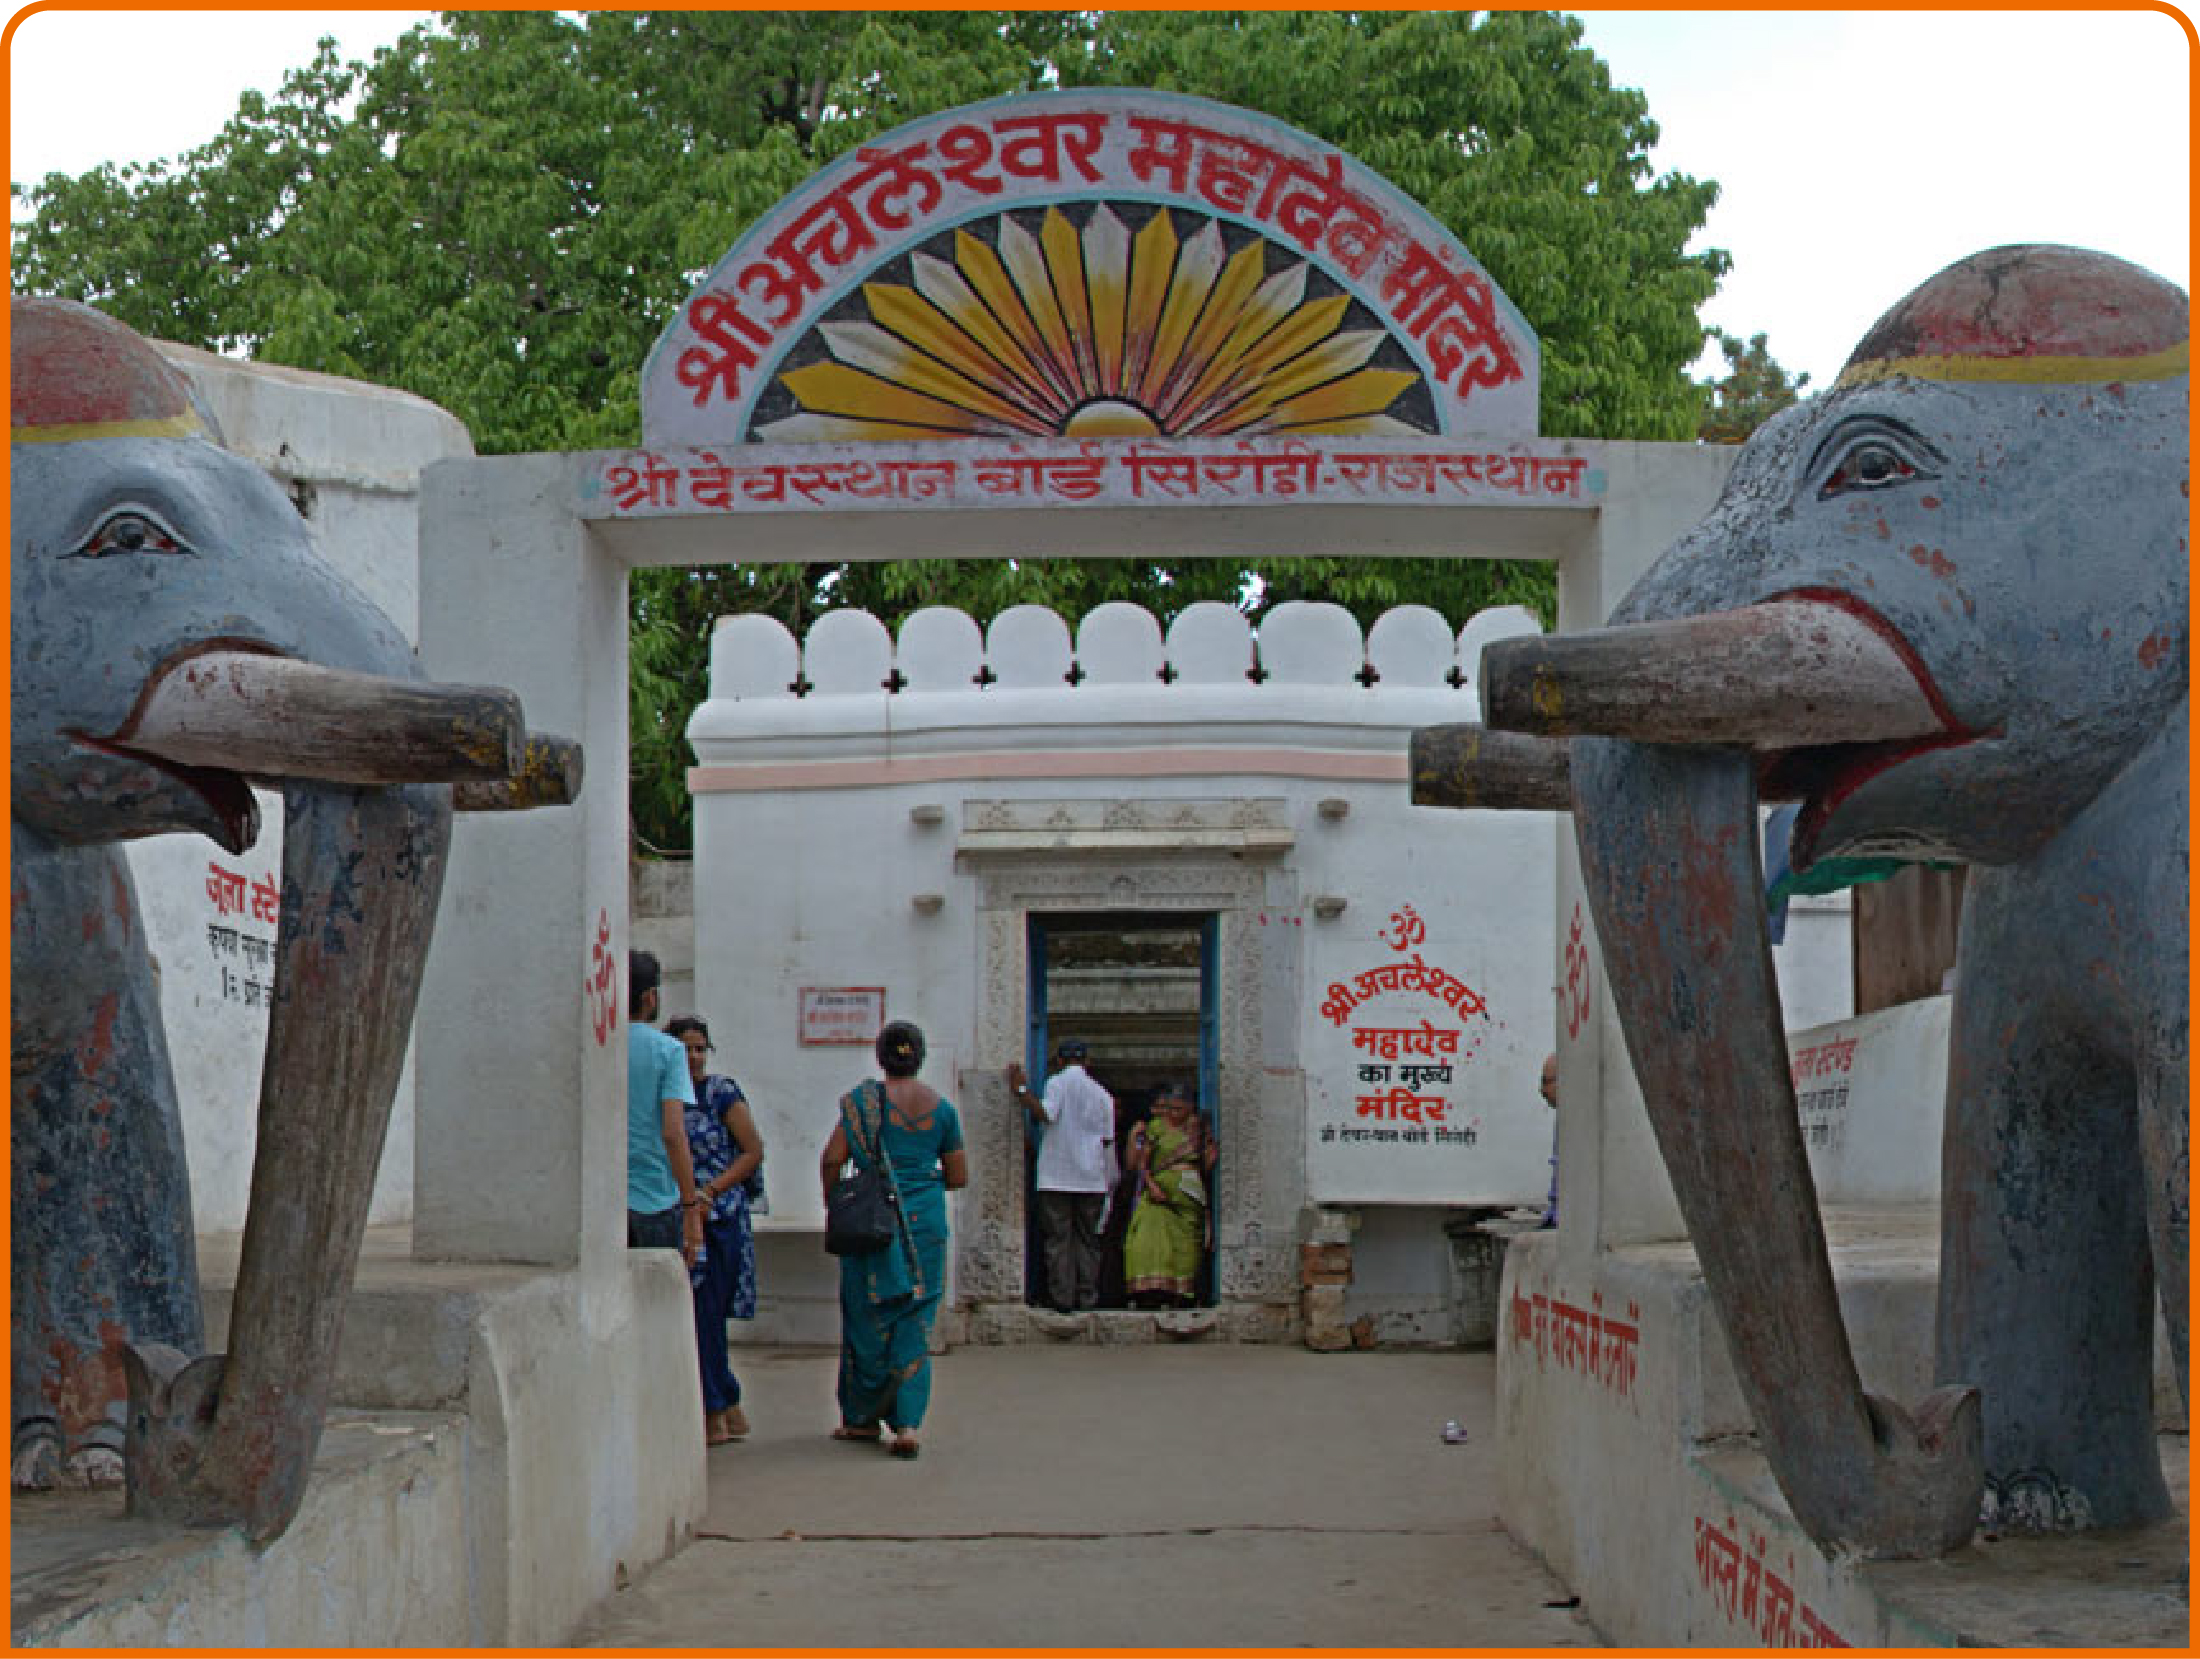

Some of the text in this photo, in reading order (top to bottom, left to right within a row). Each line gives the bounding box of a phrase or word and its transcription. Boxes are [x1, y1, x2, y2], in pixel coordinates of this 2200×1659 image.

[676, 285, 774, 408] श्री
[1127, 108, 1392, 280] महादेव
[605, 451, 679, 511] श्री
[1320, 982, 1358, 1028] श्री
[1352, 1019, 1461, 1060] महादेव
[1357, 1063, 1392, 1084] का
[1354, 1086, 1447, 1125] मंदिर
